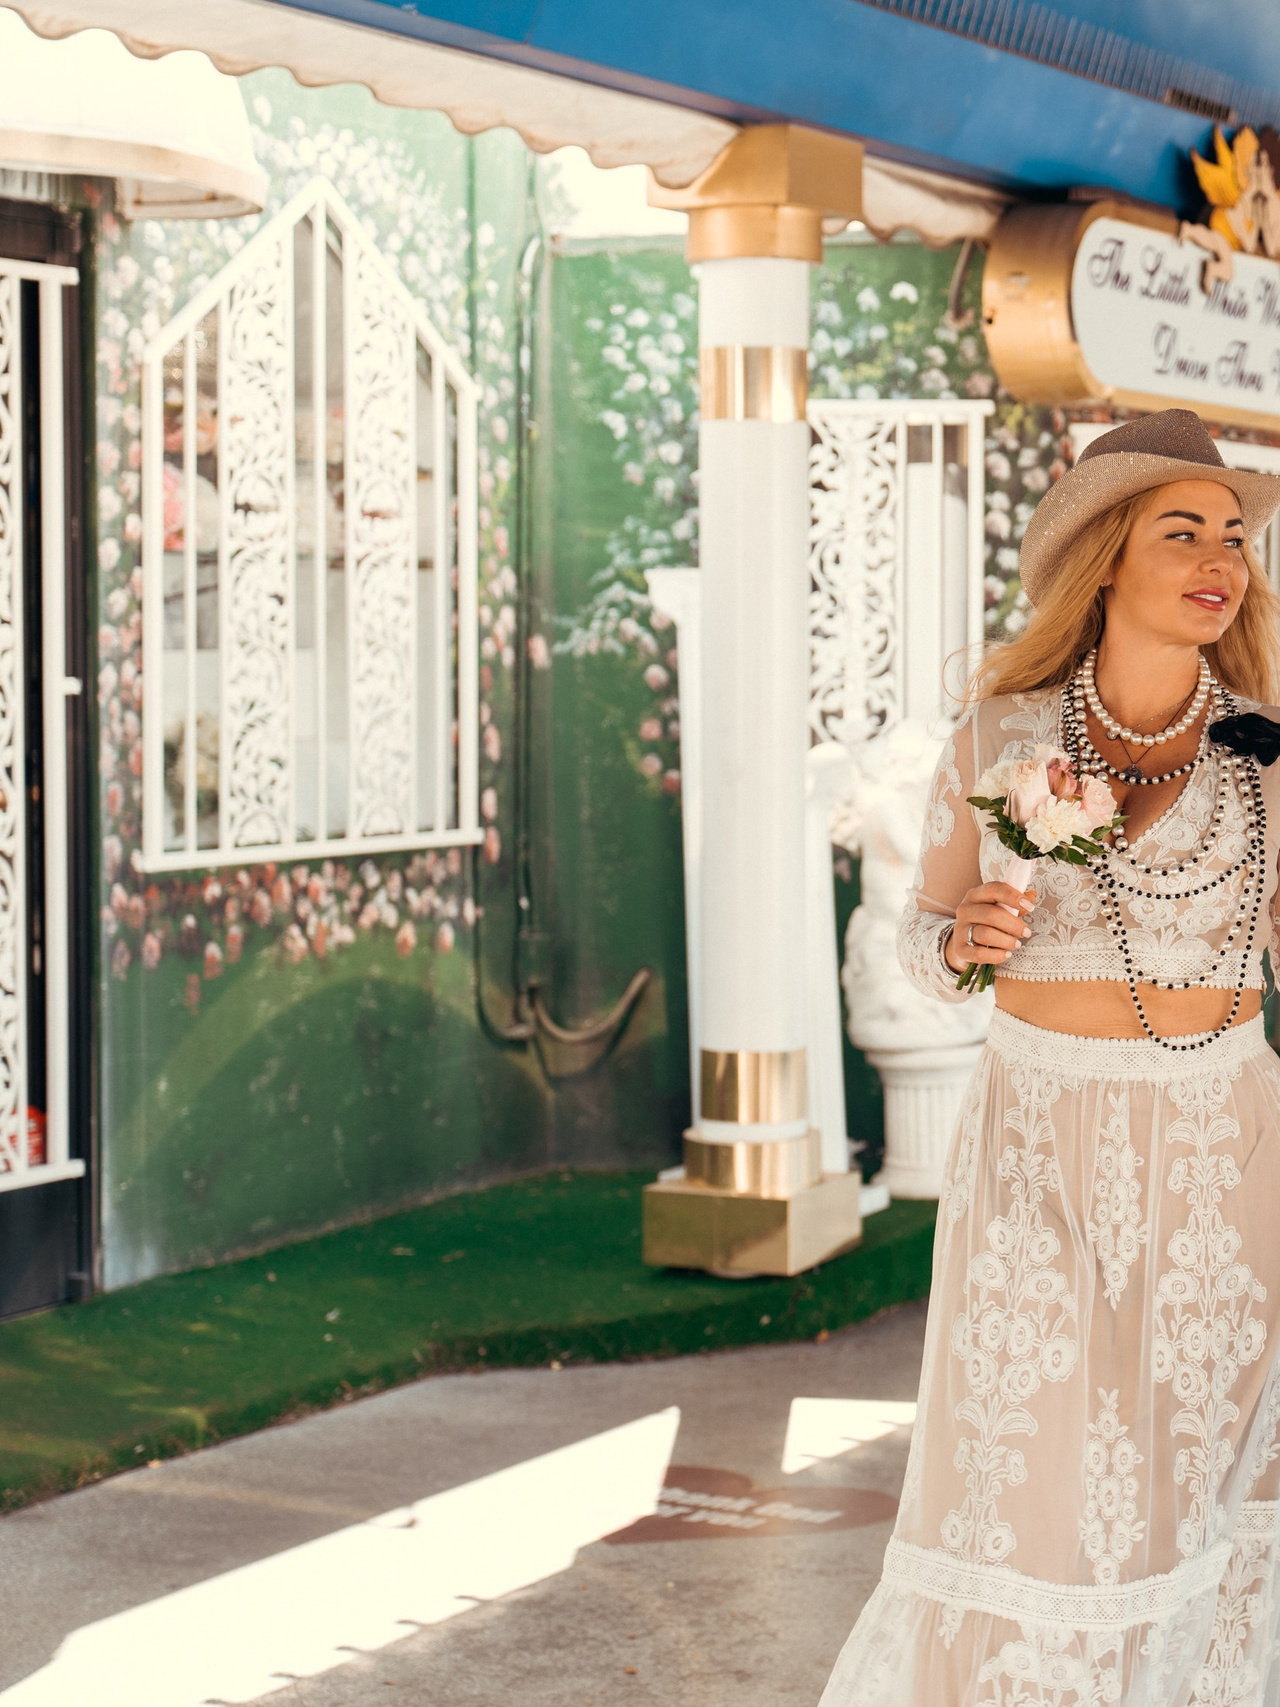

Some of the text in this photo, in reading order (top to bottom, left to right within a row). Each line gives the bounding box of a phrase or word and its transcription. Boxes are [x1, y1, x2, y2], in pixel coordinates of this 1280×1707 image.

[1086, 237, 1131, 292] The
[1139, 244, 1191, 306] Little
[1153, 320, 1209, 381] Drive
